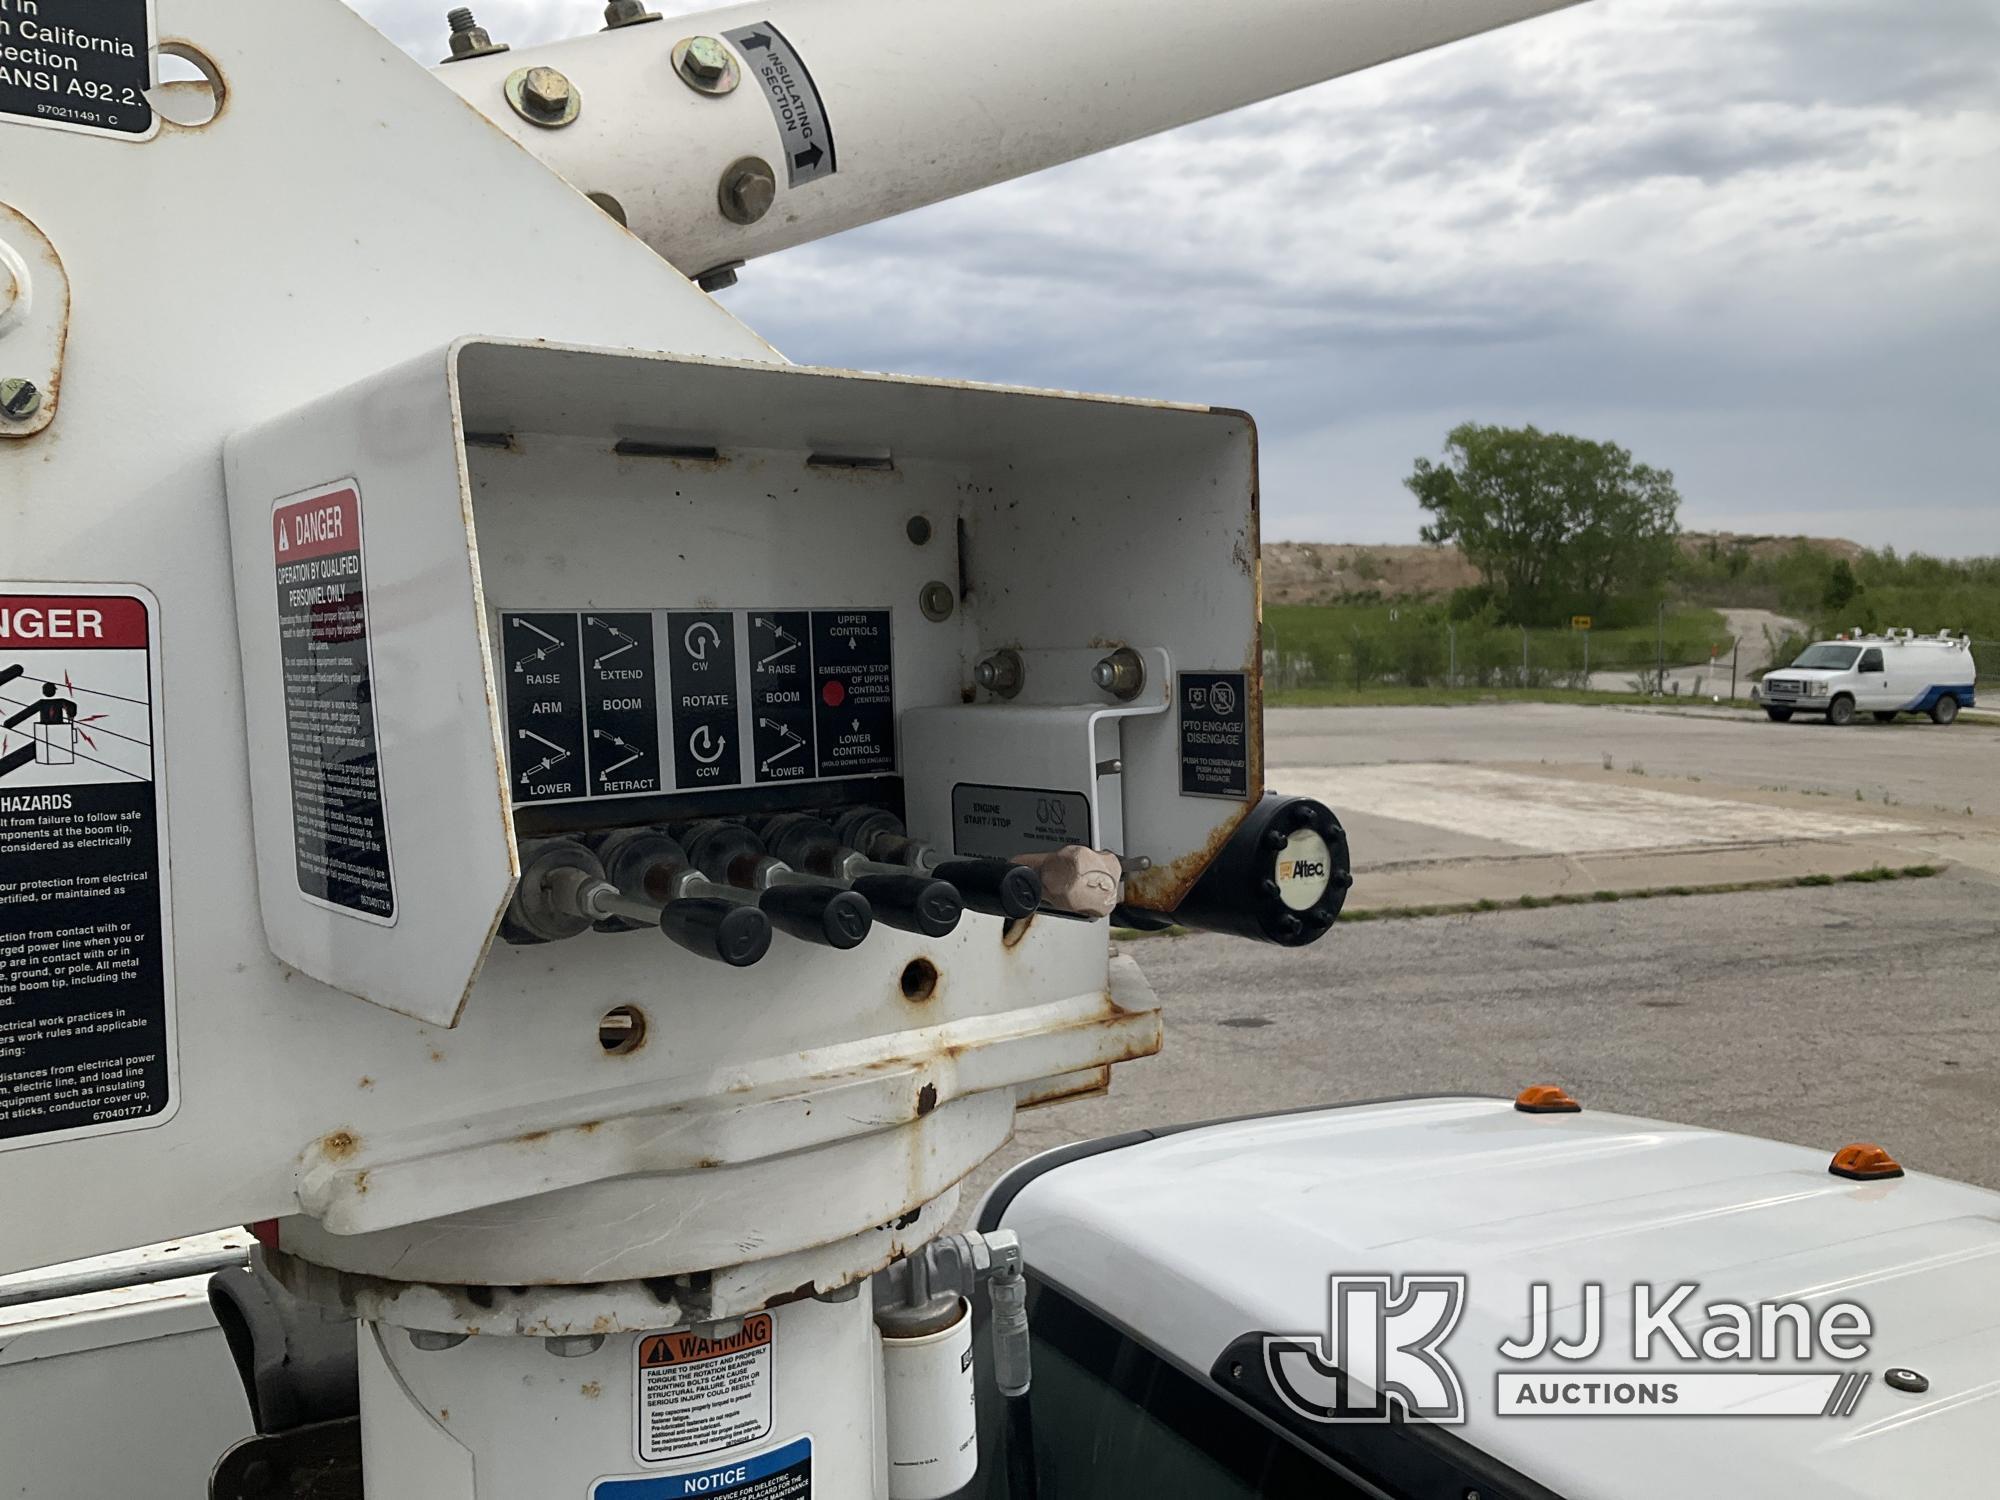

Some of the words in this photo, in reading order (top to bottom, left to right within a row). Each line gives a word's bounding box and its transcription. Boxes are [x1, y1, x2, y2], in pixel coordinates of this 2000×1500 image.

[20, 20, 135, 57] California
[0, 43, 78, 71] ection
[0, 66, 58, 92] ANSI
[66, 78, 142, 107] A92.2.
[767, 52, 813, 139] INSULATING
[761, 66, 797, 132] SECTION
[37, 103, 101, 123] 970211491
[108, 115, 118, 125] C
[296, 505, 342, 546] DANGER
[278, 563, 311, 585] OPERATION
[311, 561, 320, 580] BY
[320, 555, 359, 579] QUALIFIED
[289, 586, 326, 607] PERSONNEL
[326, 583, 346, 604] ONLY
[837, 615, 867, 624] UPPER
[830, 627, 878, 636] CONTROLS
[600, 670, 643, 680] EXTEND
[692, 662, 709, 671] CW
[768, 664, 796, 674] RAISE
[819, 665, 868, 675] EMERGENCY
[869, 664, 889, 673] STOP
[526, 674, 560, 685] RAISE
[852, 675, 863, 684] OF
[864, 674, 889, 683] UPPER
[766, 692, 800, 703] BOOM
[848, 685, 890, 694] CONTROLS
[532, 702, 562, 714] ARM
[603, 698, 642, 711] BOOM
[682, 695, 729, 707] ROTATE
[1183, 720, 1201, 731] PTO
[840, 733, 871, 744] LOWER
[1187, 733, 1239, 745] DISENGAGE
[833, 745, 880, 756] CONTROLS
[696, 767, 719, 777] CCW
[771, 766, 805, 777] LOWER
[530, 783, 571, 795] LOWER
[604, 779, 654, 792] RETRACT
[1, 794, 72, 812] HAZARDS
[972, 802, 1000, 815] ENGINE
[10, 817, 35, 827] from
[38, 815, 71, 826] failure
[73, 814, 84, 824] to
[87, 813, 117, 822] follow
[120, 810, 142, 820] safe
[53, 828, 63, 837] at
[66, 827, 82, 836] the
[85, 825, 113, 835] boom
[1, 841, 59, 853] considered
[62, 840, 74, 849] as
[77, 836, 132, 848] electrically
[20, 878, 73, 892] protection
[76, 876, 100, 885] from
[103, 872, 148, 883] electrical
[41, 893, 52, 901] or
[55, 887, 111, 899] maintained
[114, 886, 126, 895] as
[29, 930, 53, 940] from
[56, 926, 94, 937] contact
[97, 923, 118, 933] with
[120, 922, 131, 931] or
[27, 942, 59, 954] power
[62, 940, 81, 949] line
[84, 937, 110, 947] when
[114, 935, 131, 946] you
[134, 933, 145, 941] or
[9, 958, 27, 967] are
[29, 956, 39, 965] in
[42, 952, 80, 963] contact
[83, 949, 104, 959] with
[107, 949, 118, 957] or
[120, 946, 130, 955] in
[54, 966, 65, 975] or
[96, 961, 110, 970] All
[112, 958, 139, 968] metal
[0, 984, 17, 993] the
[20, 981, 49, 991] boom
[71, 973, 118, 986] including
[121, 971, 137, 980] the
[39, 1016, 65, 1026] work
[67, 1010, 114, 1025] practices
[116, 1008, 126, 1017] in
[17, 1031, 43, 1042] work
[46, 1028, 72, 1038] rules
[75, 1024, 94, 1035] and
[96, 1018, 147, 1032] applicable
[51, 1065, 74, 1076] from
[77, 1058, 123, 1072] electrical
[126, 1054, 156, 1066] power
[14, 1082, 52, 1093] electric
[80, 1074, 99, 1084] and
[101, 1069, 123, 1080] load
[126, 1067, 144, 1077] line
[54, 1089, 79, 1100] such
[81, 1086, 93, 1095] as
[96, 1080, 145, 1094] insulating
[49, 1099, 100, 1113] conductor
[103, 1094, 131, 1104] cover
[93, 1105, 142, 1121] 67040177
[145, 1104, 152, 1113] J
[647, 1367, 677, 1377] FAILURE
[689, 1361, 718, 1372] INSPECT
[720, 1356, 733, 1364] AND
[735, 1347, 767, 1361] PROPERLY
[648, 1375, 677, 1384] TORQUE
[678, 1372, 691, 1381] THE
[693, 1366, 726, 1378] ROTATION
[727, 1358, 756, 1370] BEARING
[647, 1381, 685, 1392] MOUNTING
[687, 1377, 710, 1387] BOLTS
[711, 1373, 725, 1382] CAN
[726, 1367, 748, 1378] CAUSE
[647, 1387, 694, 1399] STRUCTURAL
[728, 1375, 749, 1385] DEATH
[750, 1371, 760, 1379] OR
[647, 1396, 679, 1407] SERIOUS
[680, 1392, 705, 1403] INJURY
[707, 1387, 730, 1397] COULD
[684, 1466, 746, 1493] NOTICE
[740, 1487, 753, 1496] FOR
[754, 1473, 789, 1492] DIELECTRIC
[748, 1485, 777, 1500] PLACARD
[778, 1480, 791, 1489] FOR
[791, 1475, 802, 1484] THE
[770, 1479, 809, 1500] MAINTENANCE
